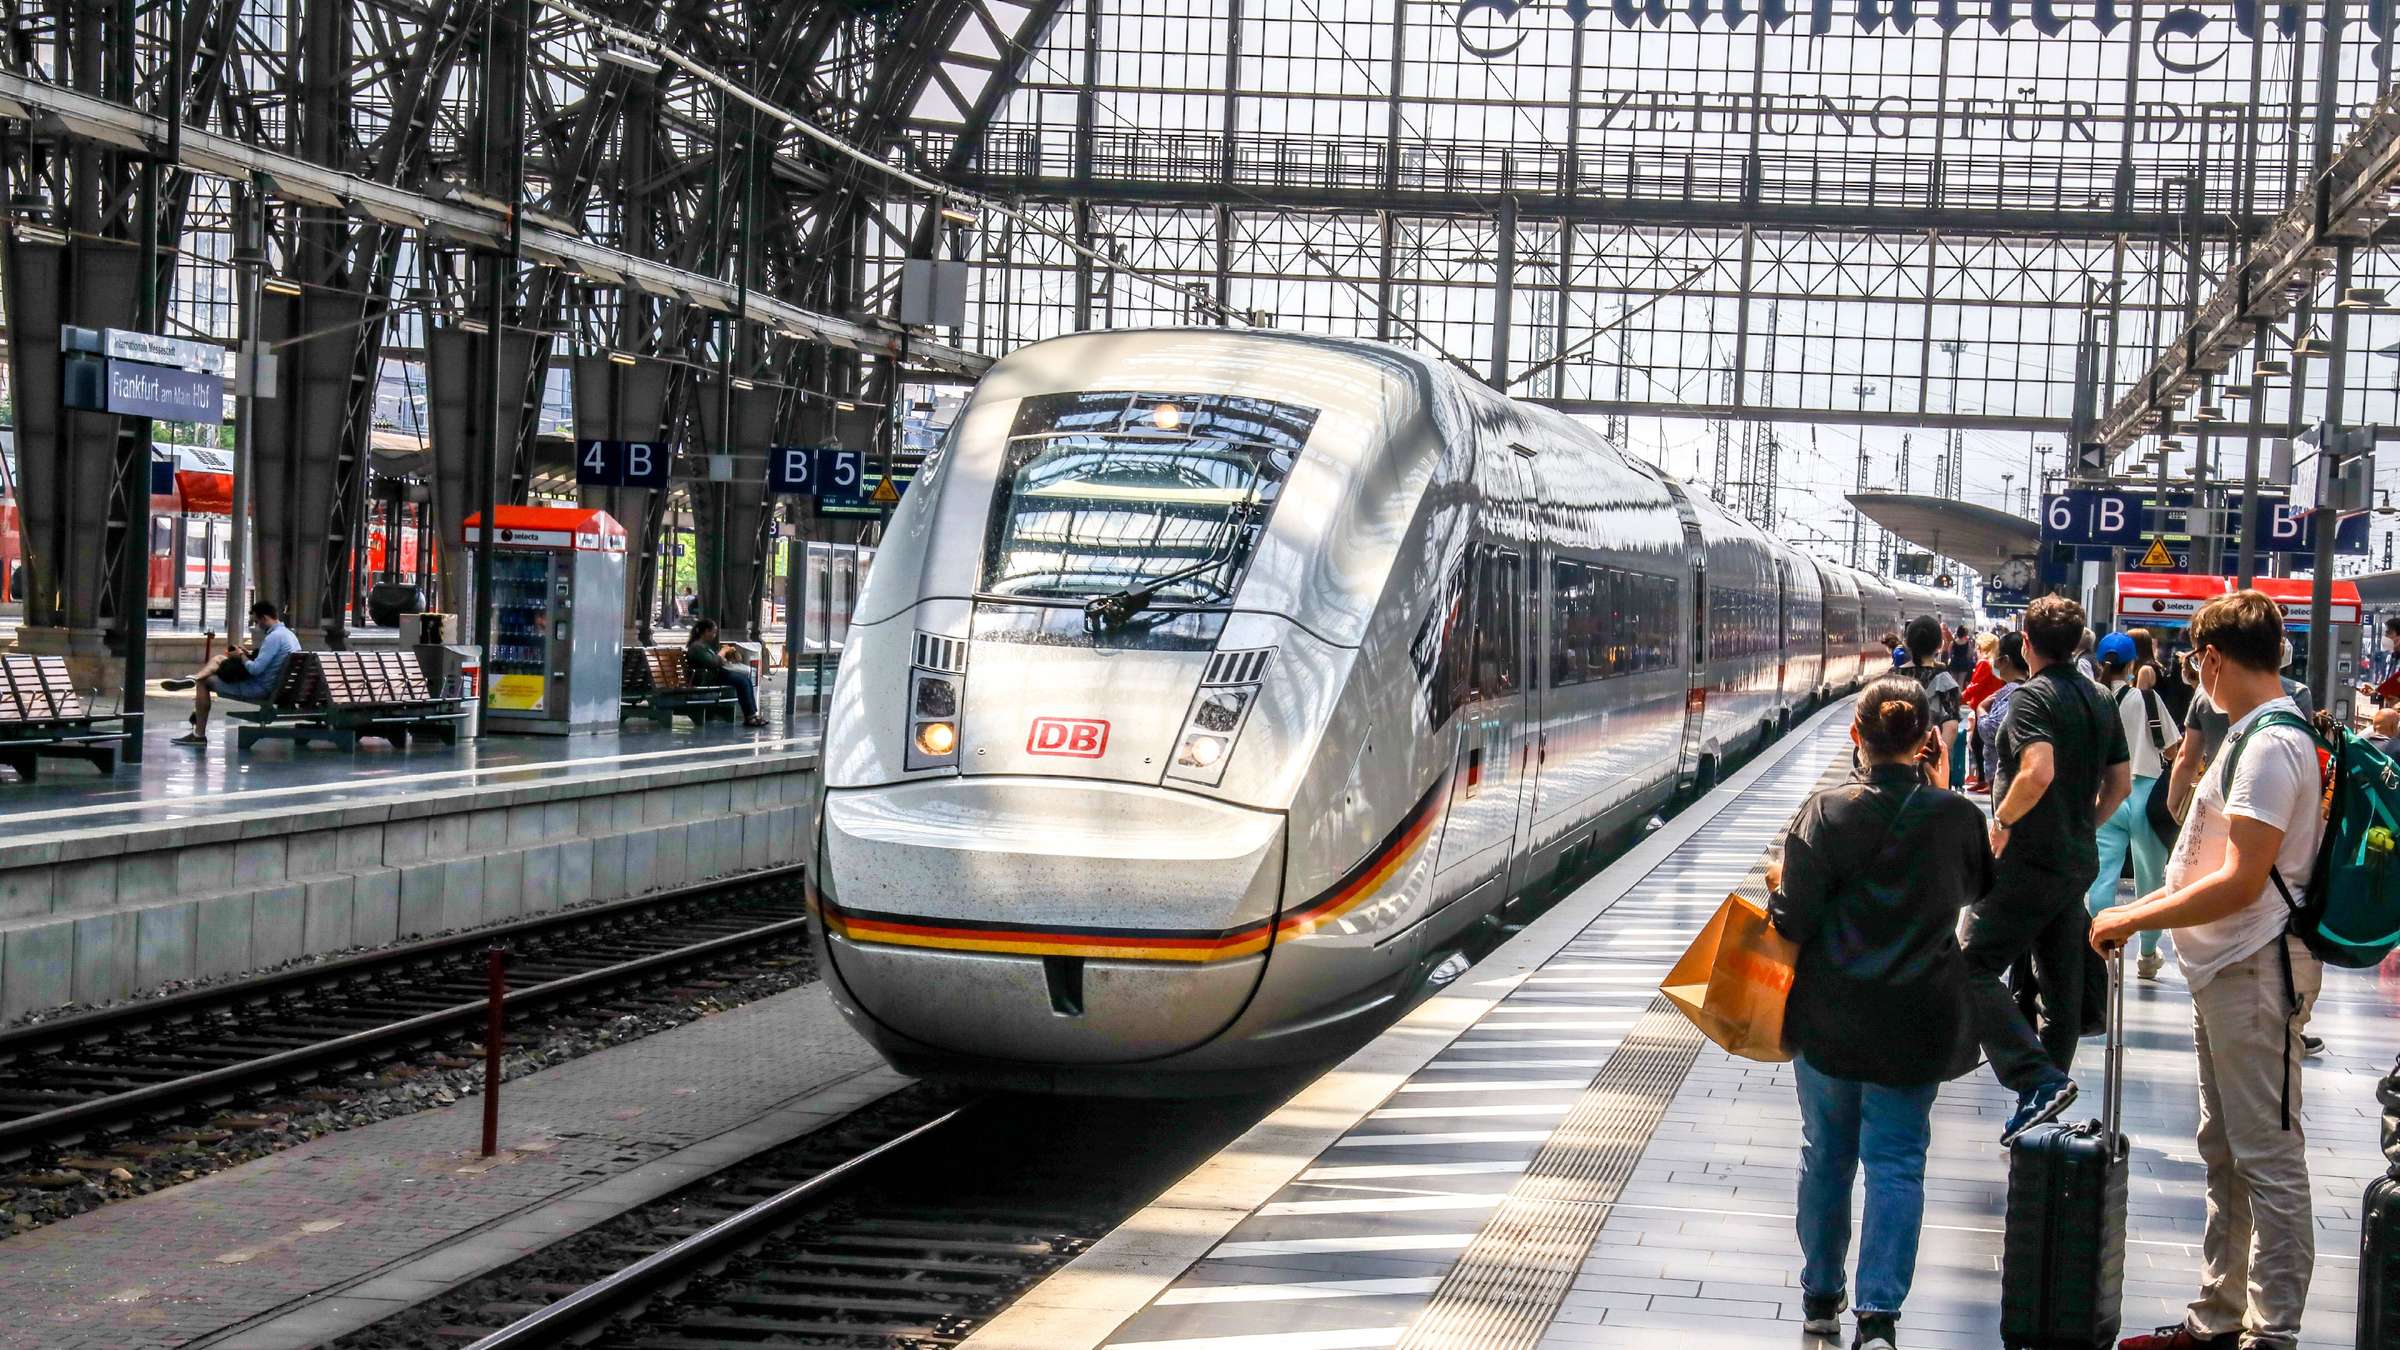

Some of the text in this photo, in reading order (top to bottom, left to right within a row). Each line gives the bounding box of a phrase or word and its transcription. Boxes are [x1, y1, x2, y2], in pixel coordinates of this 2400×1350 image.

[1598, 88, 1913, 140] ZEITUNG
[1956, 87, 2098, 144] FÜR
[113, 371, 210, 409] Frankfurt am Main Hbf
[583, 441, 653, 476] 4 B
[784, 450, 856, 486] B 5
[2049, 496, 2125, 532] 6 B
[2272, 503, 2299, 538] B
[513, 532, 539, 542] selecta
[2179, 555, 2188, 568] 8
[1993, 574, 2002, 590] 6
[2166, 602, 2194, 611] selecta
[2290, 607, 2312, 616] selec
[1037, 722, 1098, 751] DB
